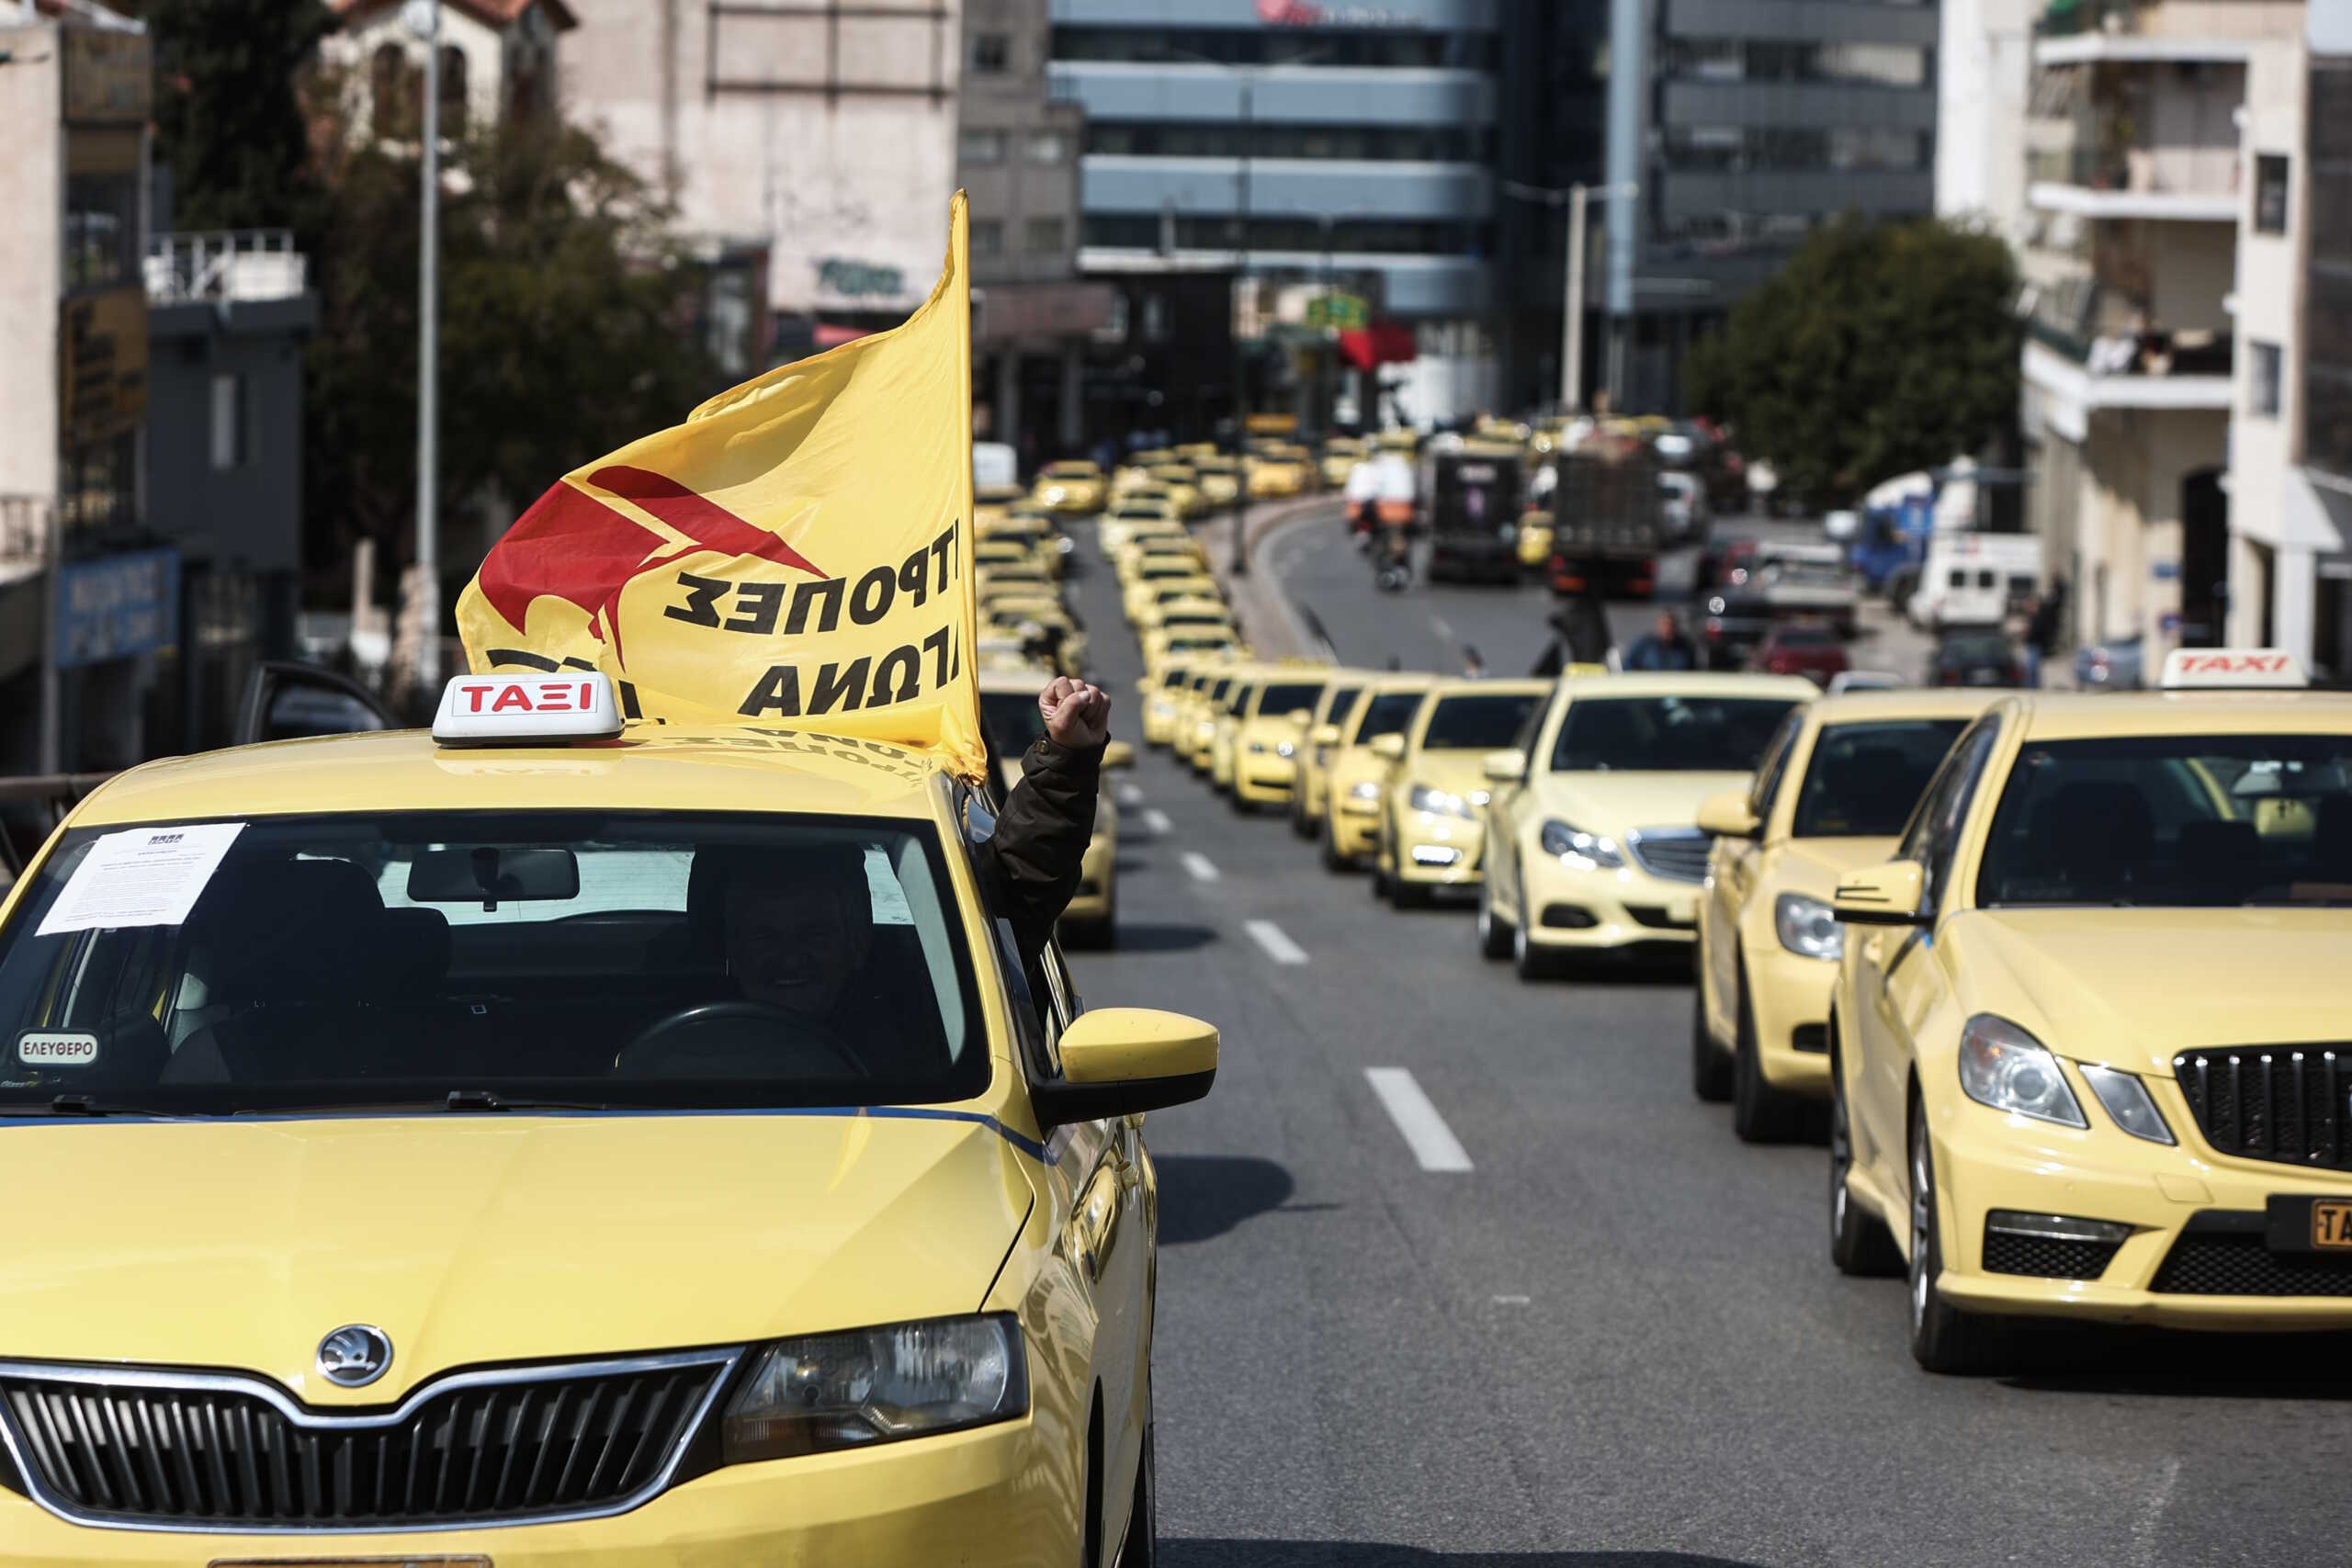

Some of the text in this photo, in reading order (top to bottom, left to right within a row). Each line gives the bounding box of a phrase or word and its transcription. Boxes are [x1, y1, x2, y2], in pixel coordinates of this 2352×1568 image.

[2179, 655, 2290, 673] TAXI
[461, 682, 592, 713] ΤΑΞΙ
[23, 1041, 94, 1056] ΕΛΕΥΘΕΡΟ
